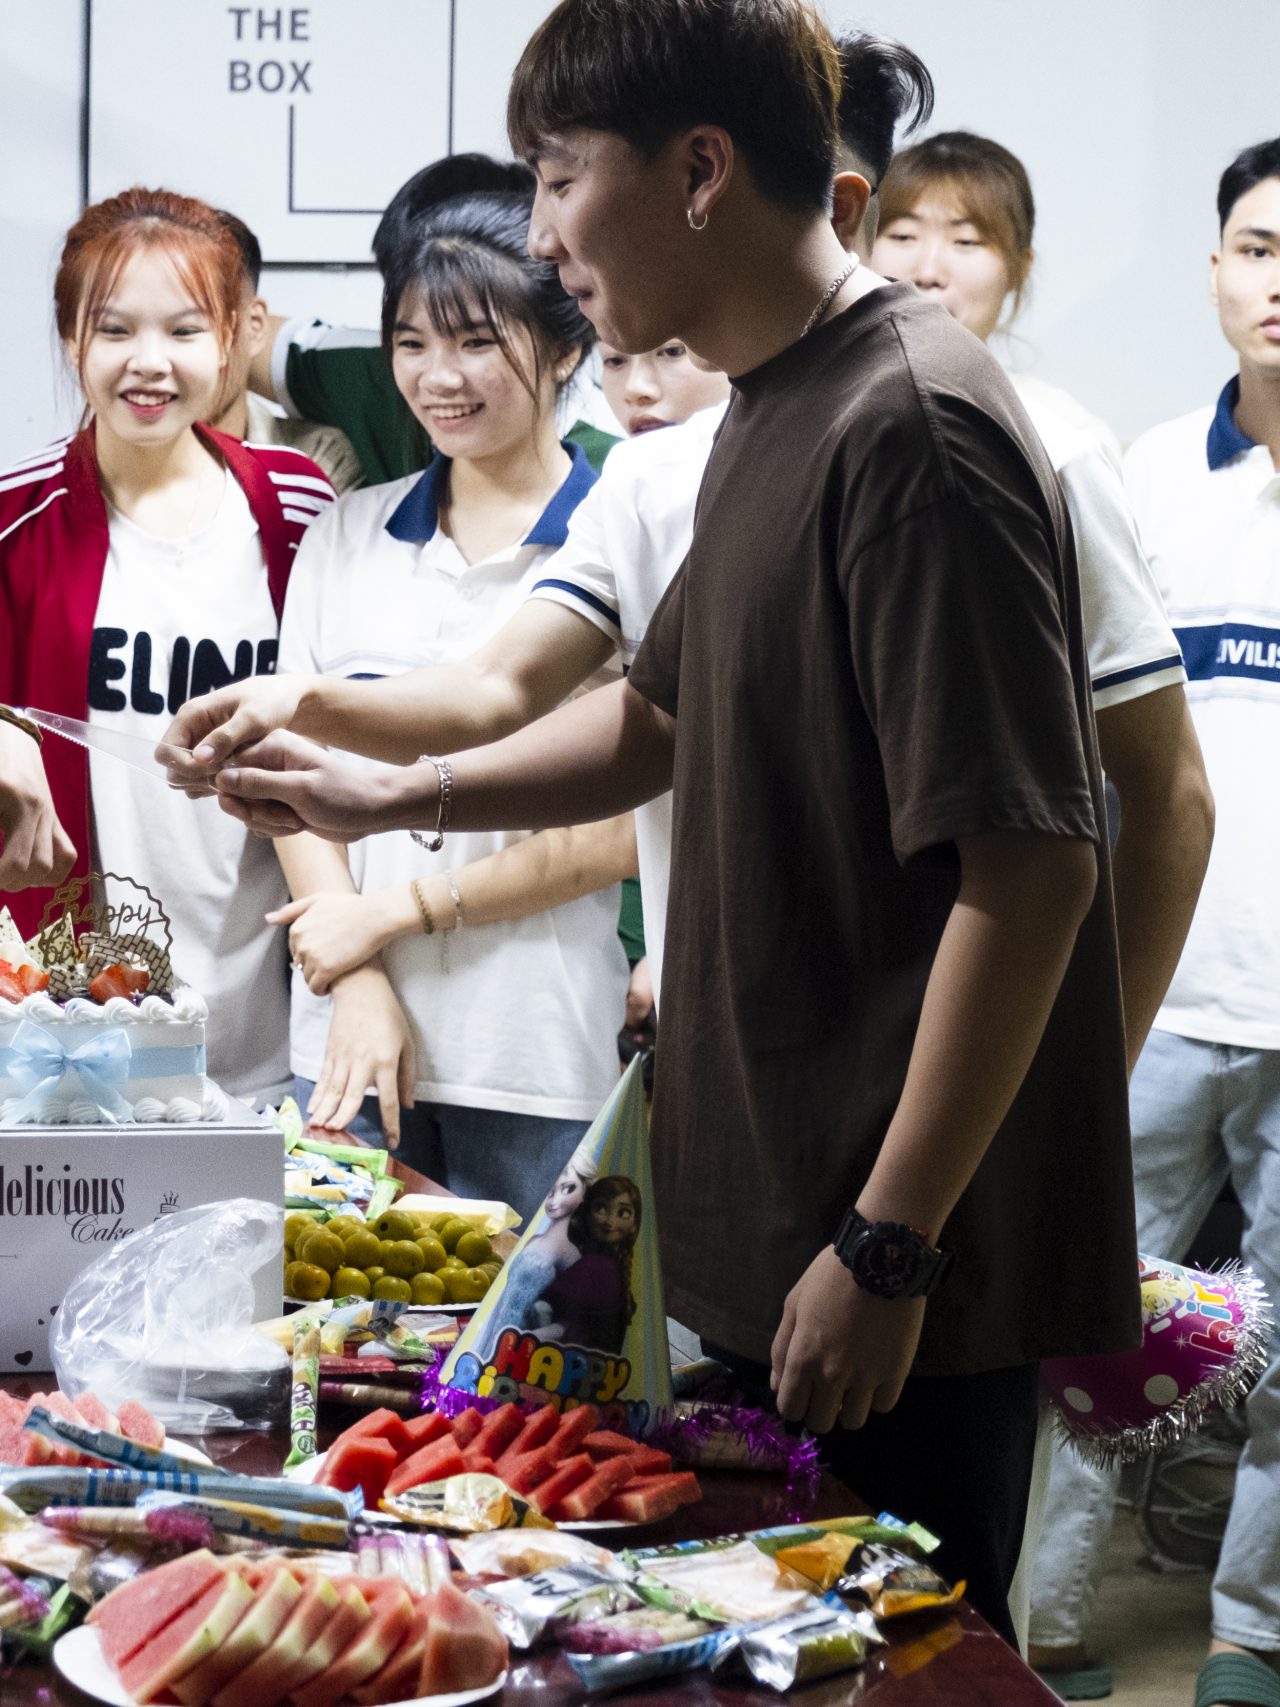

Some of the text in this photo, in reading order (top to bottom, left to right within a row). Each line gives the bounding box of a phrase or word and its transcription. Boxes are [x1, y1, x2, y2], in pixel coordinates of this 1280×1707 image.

[228, 8, 310, 42] THE
[229, 60, 312, 94] BOX
[65, 1210, 135, 1244] Cake
[492, 1329, 631, 1403] HAPPY
